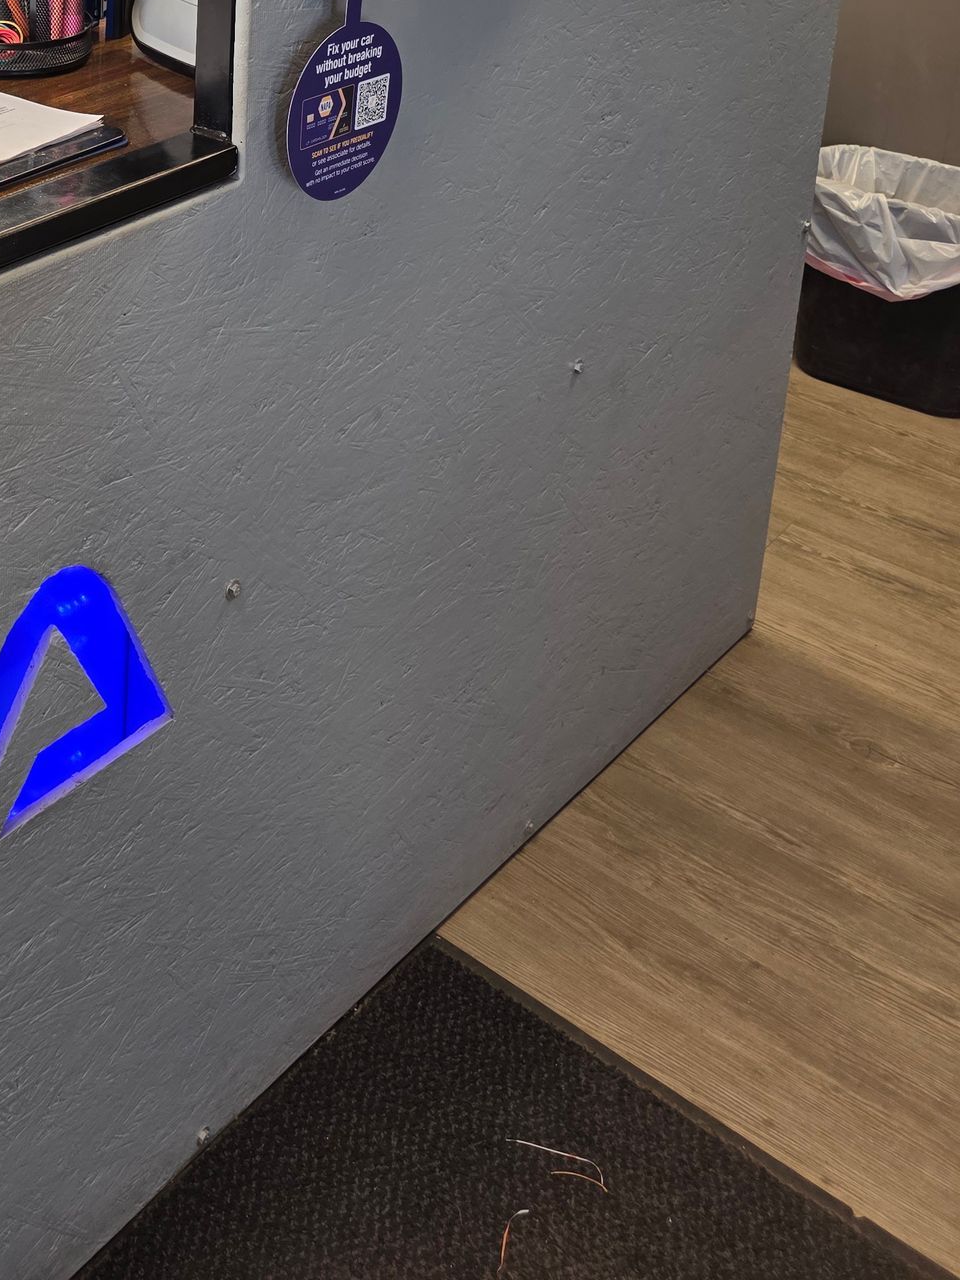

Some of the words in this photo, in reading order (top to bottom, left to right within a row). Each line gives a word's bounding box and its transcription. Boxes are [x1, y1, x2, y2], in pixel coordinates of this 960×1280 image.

[327, 42, 340, 57] Fix
[341, 38, 360, 55] your
[361, 33, 375, 45] car
[315, 56, 347, 75] without
[348, 45, 383, 64] breaking
[324, 72, 343, 89] your
[344, 62, 372, 81] budget
[327, 150, 349, 162] associate
[351, 152, 368, 162] decision
